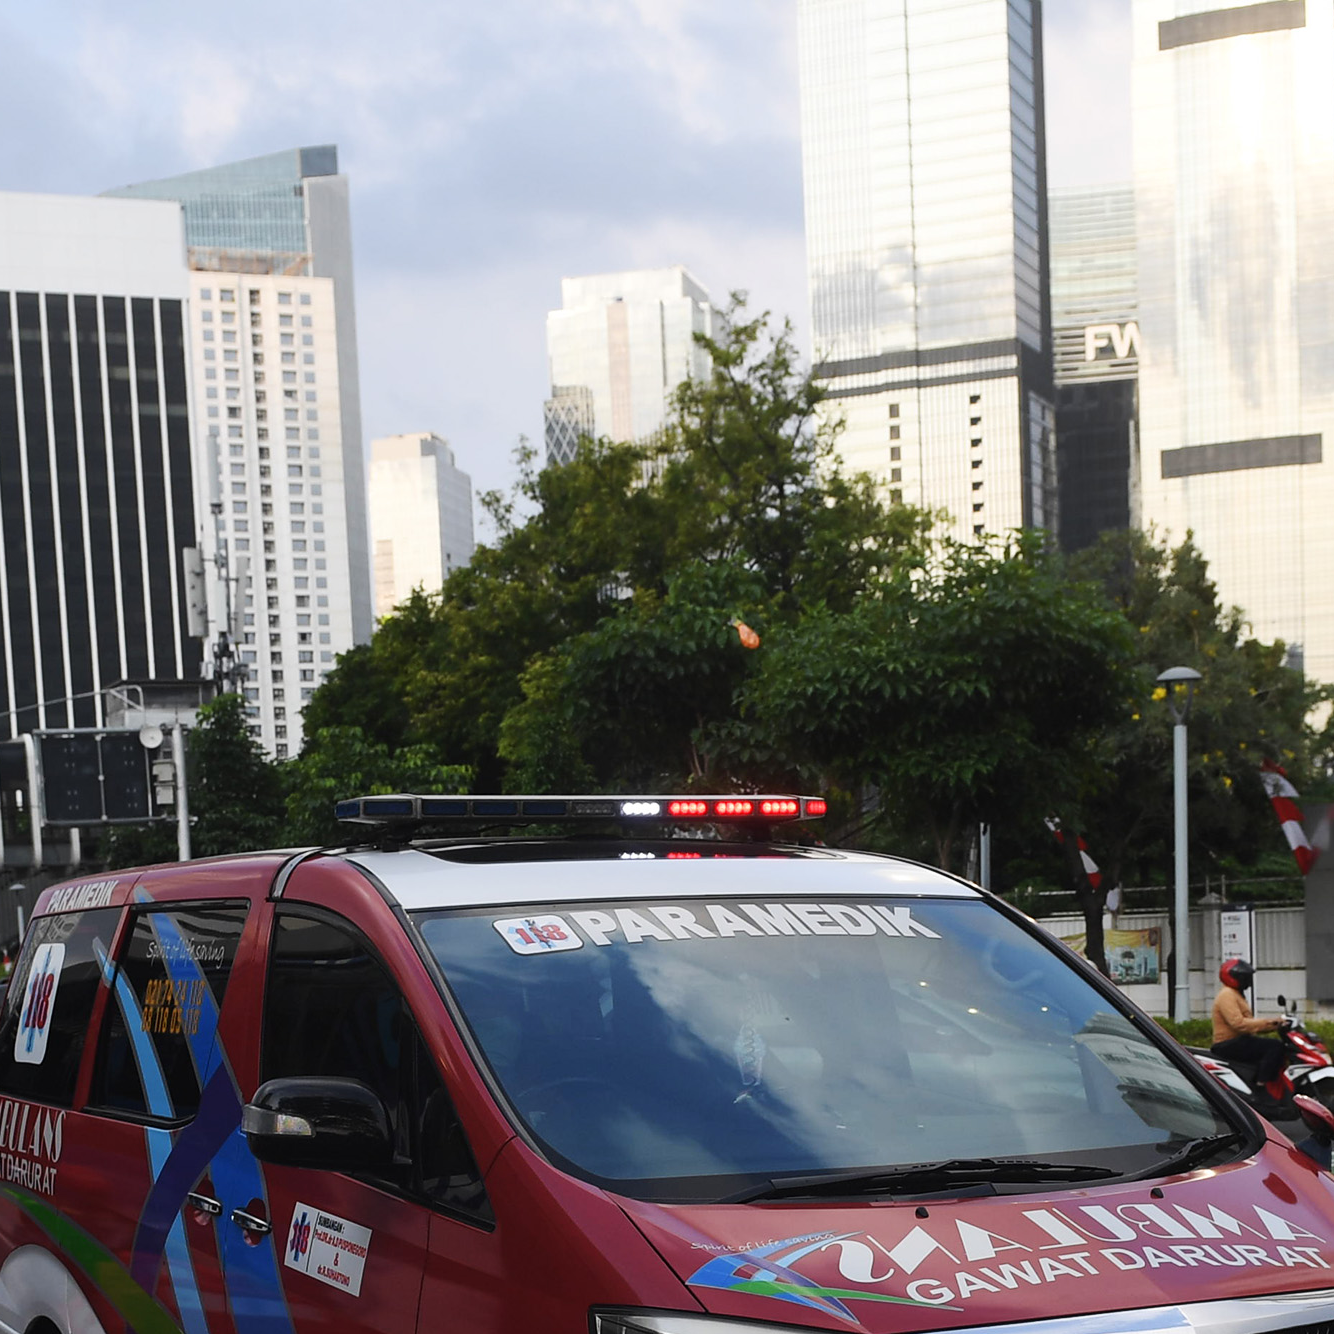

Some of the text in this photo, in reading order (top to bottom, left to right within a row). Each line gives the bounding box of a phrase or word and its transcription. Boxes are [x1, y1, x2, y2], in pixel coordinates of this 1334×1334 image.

[45, 880, 119, 914] PARAMEDIK
[568, 904, 943, 947] PARAMEDIK
[146, 939, 171, 967] Spirit
[24, 972, 55, 1030] 118
[144, 979, 163, 1006] 021
[154, 1007, 169, 1033] 118
[6, 1152, 58, 1197] DARURAT
[690, 1241, 735, 1252] Spirit
[738, 1242, 752, 1253] of
[784, 1233, 836, 1244] saving
[333, 1252, 340, 1267] &
[905, 1245, 1332, 1306] GAWAT DARURAT
